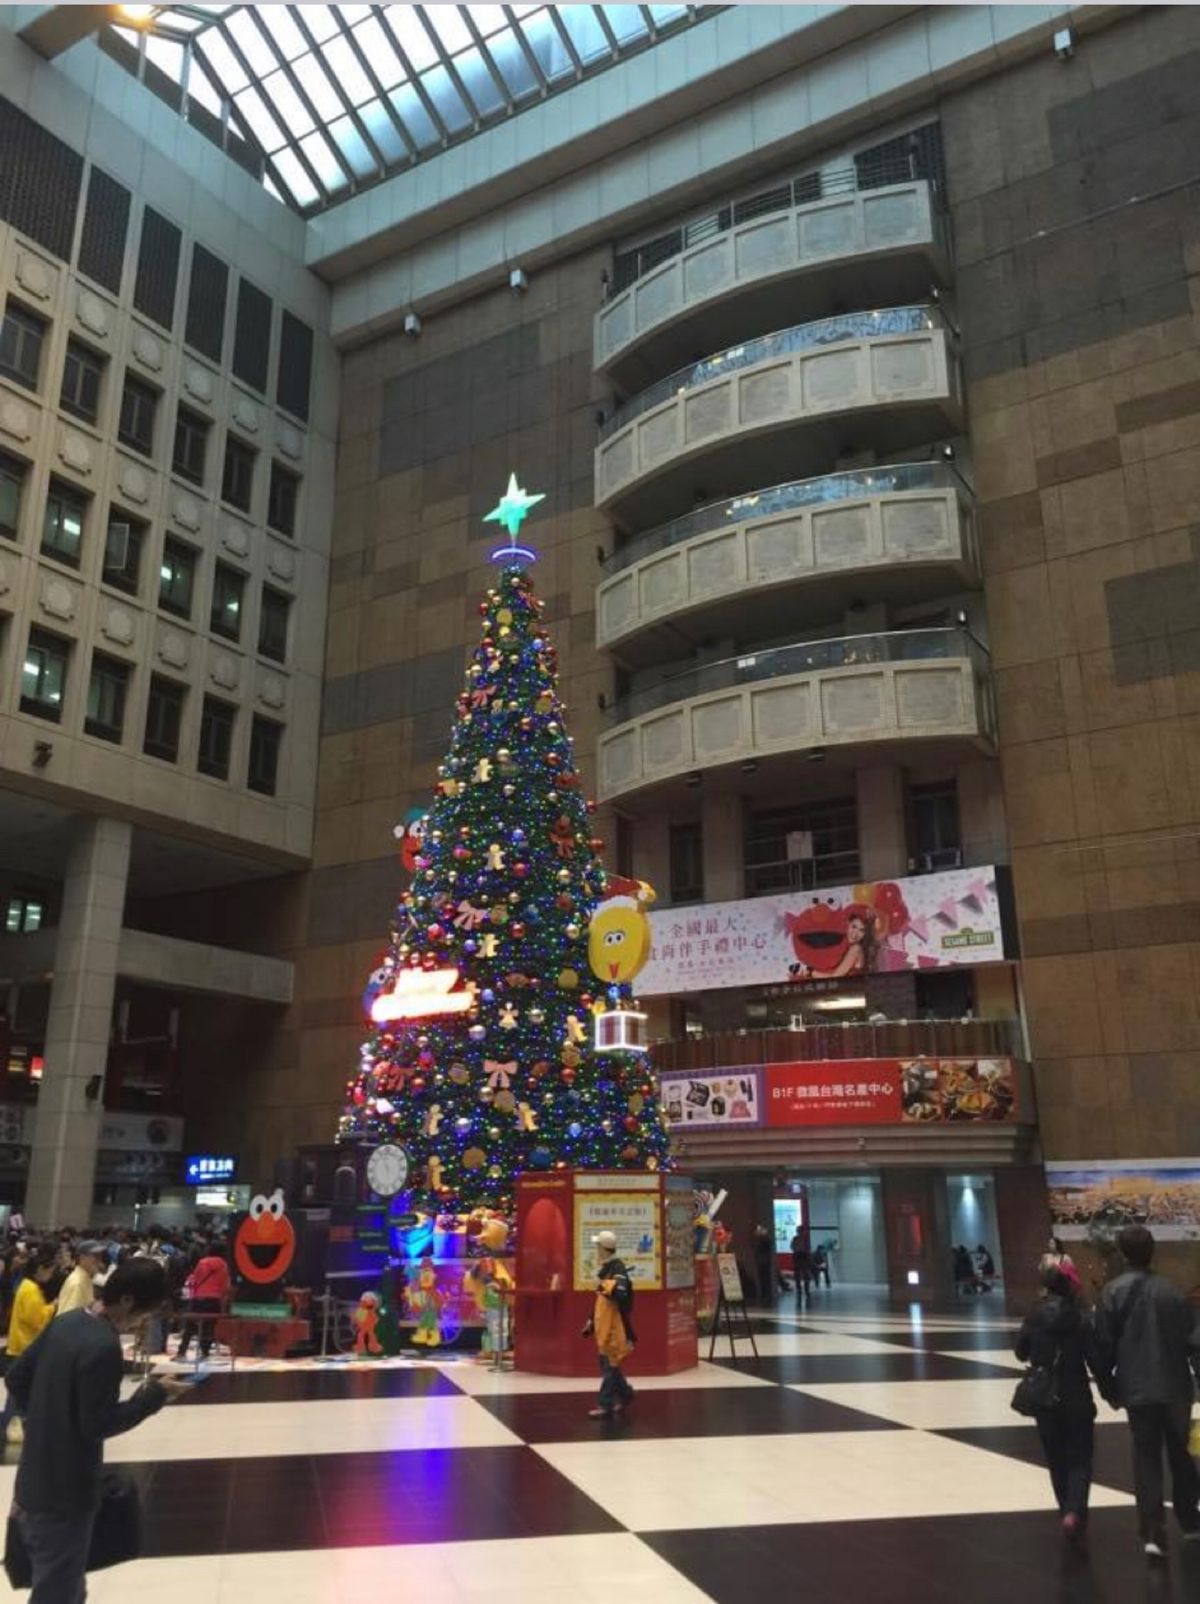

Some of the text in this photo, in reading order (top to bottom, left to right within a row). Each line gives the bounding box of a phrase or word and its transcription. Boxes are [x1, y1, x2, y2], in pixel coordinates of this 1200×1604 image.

[669, 915, 738, 938] 全國最大
[772, 1086, 794, 1099] B1F
